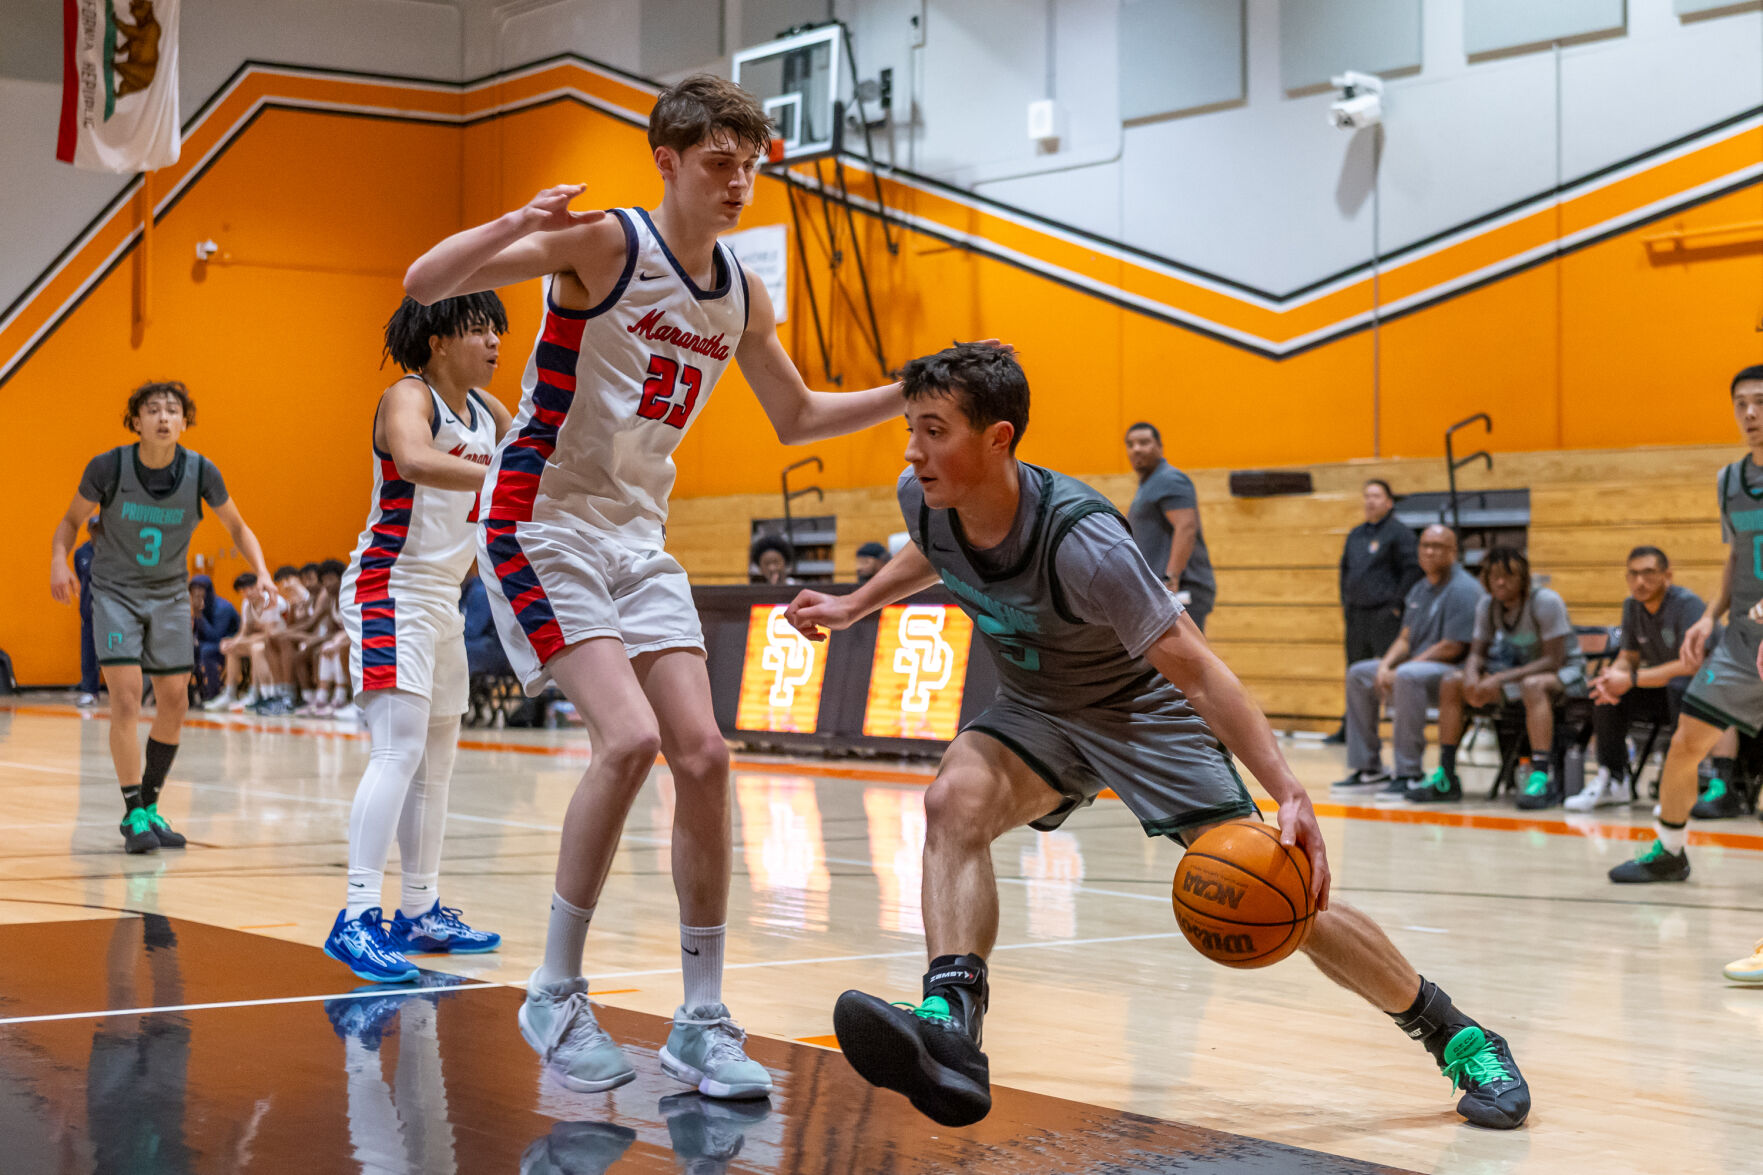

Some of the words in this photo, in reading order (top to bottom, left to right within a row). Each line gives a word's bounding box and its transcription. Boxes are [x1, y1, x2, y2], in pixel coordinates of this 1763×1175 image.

[627, 308, 730, 361] Maranatha
[636, 353, 703, 430] 23
[136, 527, 162, 566] 3
[1183, 871, 1246, 910] NCAA
